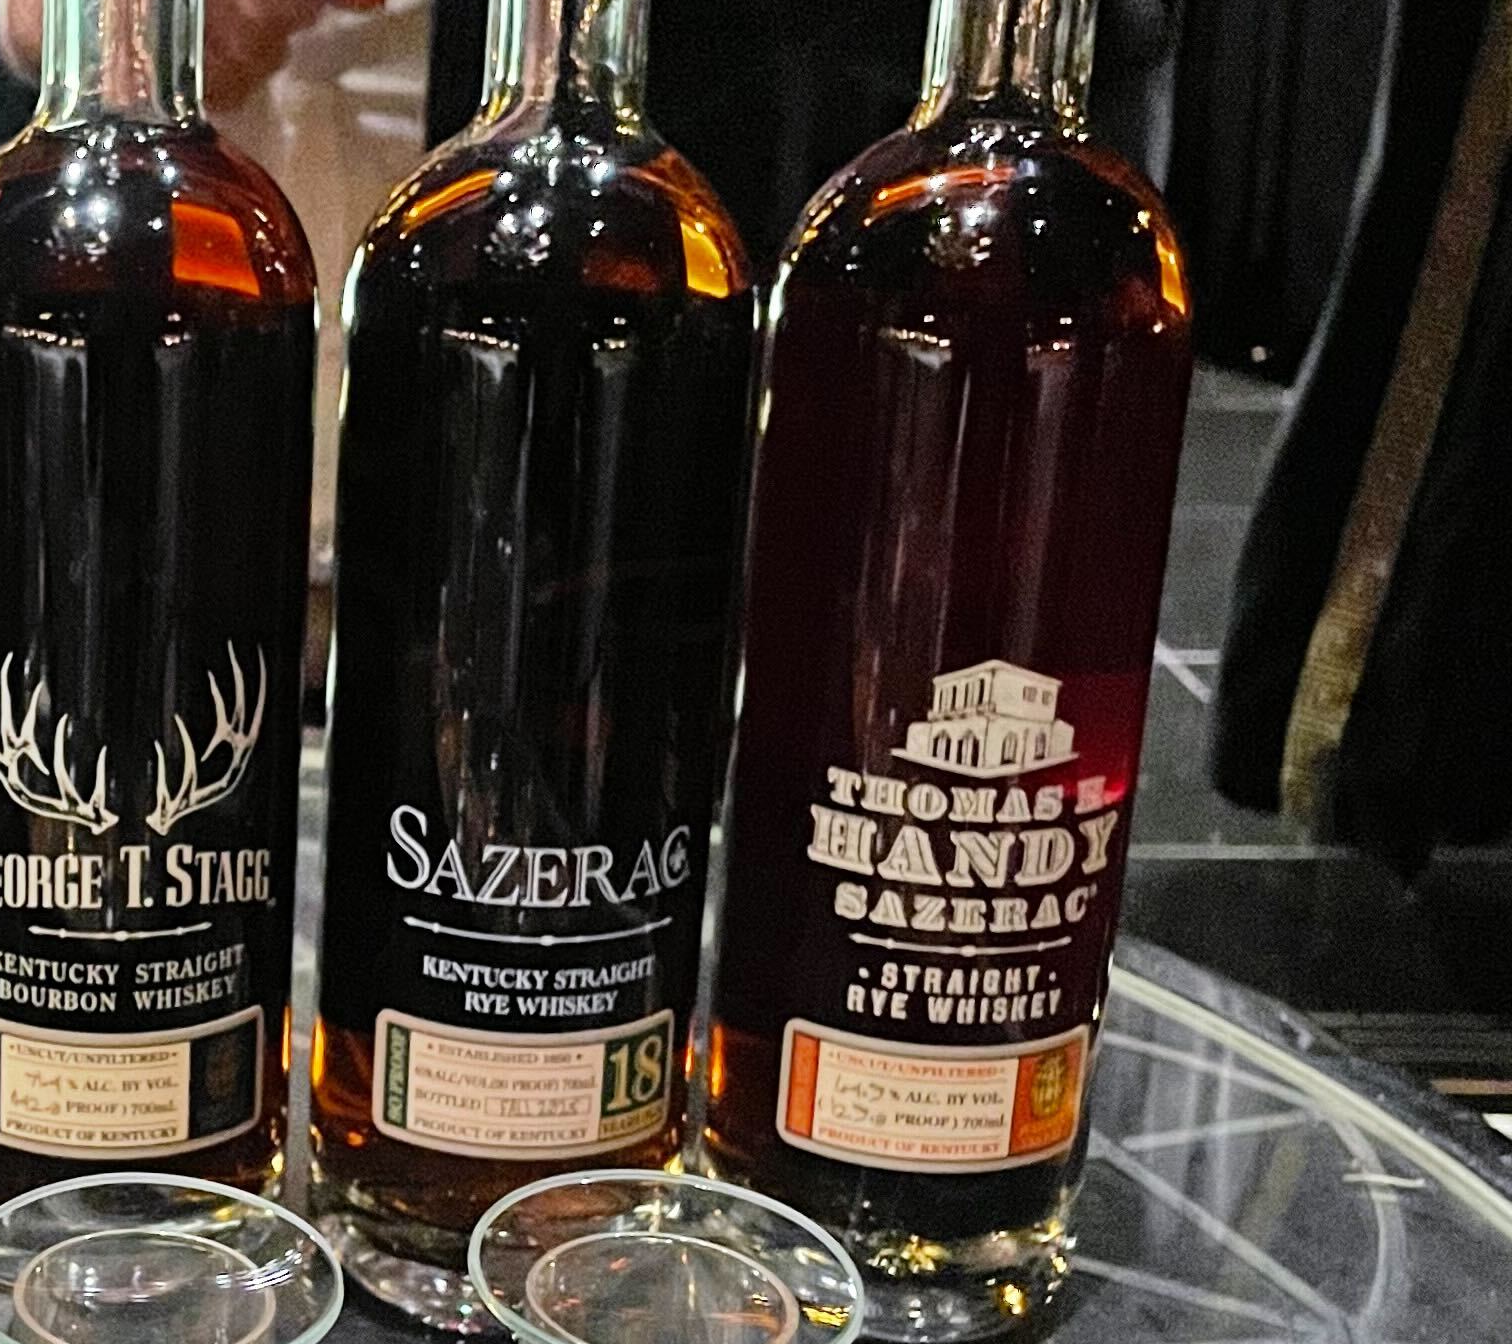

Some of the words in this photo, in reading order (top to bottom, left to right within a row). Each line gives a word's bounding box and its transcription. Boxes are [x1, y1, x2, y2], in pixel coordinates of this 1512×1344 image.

[827, 765, 1065, 824] THOMAS
[387, 804, 691, 908] SAZERAC
[807, 802, 1119, 889] HANDY
[120, 845, 154, 909] T.
[166, 844, 271, 908] STAGG
[833, 882, 1090, 934] SAZERAC
[134, 943, 245, 984] STRAIGHT
[423, 954, 548, 991] KENTUCKY
[553, 953, 656, 990] STRAIGHT
[880, 962, 1041, 996] STRAIGHT
[0, 977, 117, 1013] BOURBON
[133, 974, 237, 1011] WHISKEY
[464, 989, 509, 1016] RYE
[516, 988, 619, 1017] WHISKEY
[847, 983, 909, 1020] RYE
[927, 987, 1062, 1025] WHISKEY
[122, 1079, 143, 1092] BY
[607, 1034, 663, 1112] 18
[66, 1100, 119, 1115] PROOF
[414, 1087, 481, 1111] BOTTLED
[946, 1092, 967, 1106] BY
[5, 1118, 74, 1141] PRODUCT
[76, 1128, 97, 1142] OF
[100, 1125, 178, 1142] KENTUCKY
[414, 1116, 481, 1140] PRODUCT
[484, 1128, 504, 1142] OF
[508, 1126, 589, 1142] KENTUCKY
[894, 1112, 950, 1128] PROOF
[894, 1140, 914, 1152] OF
